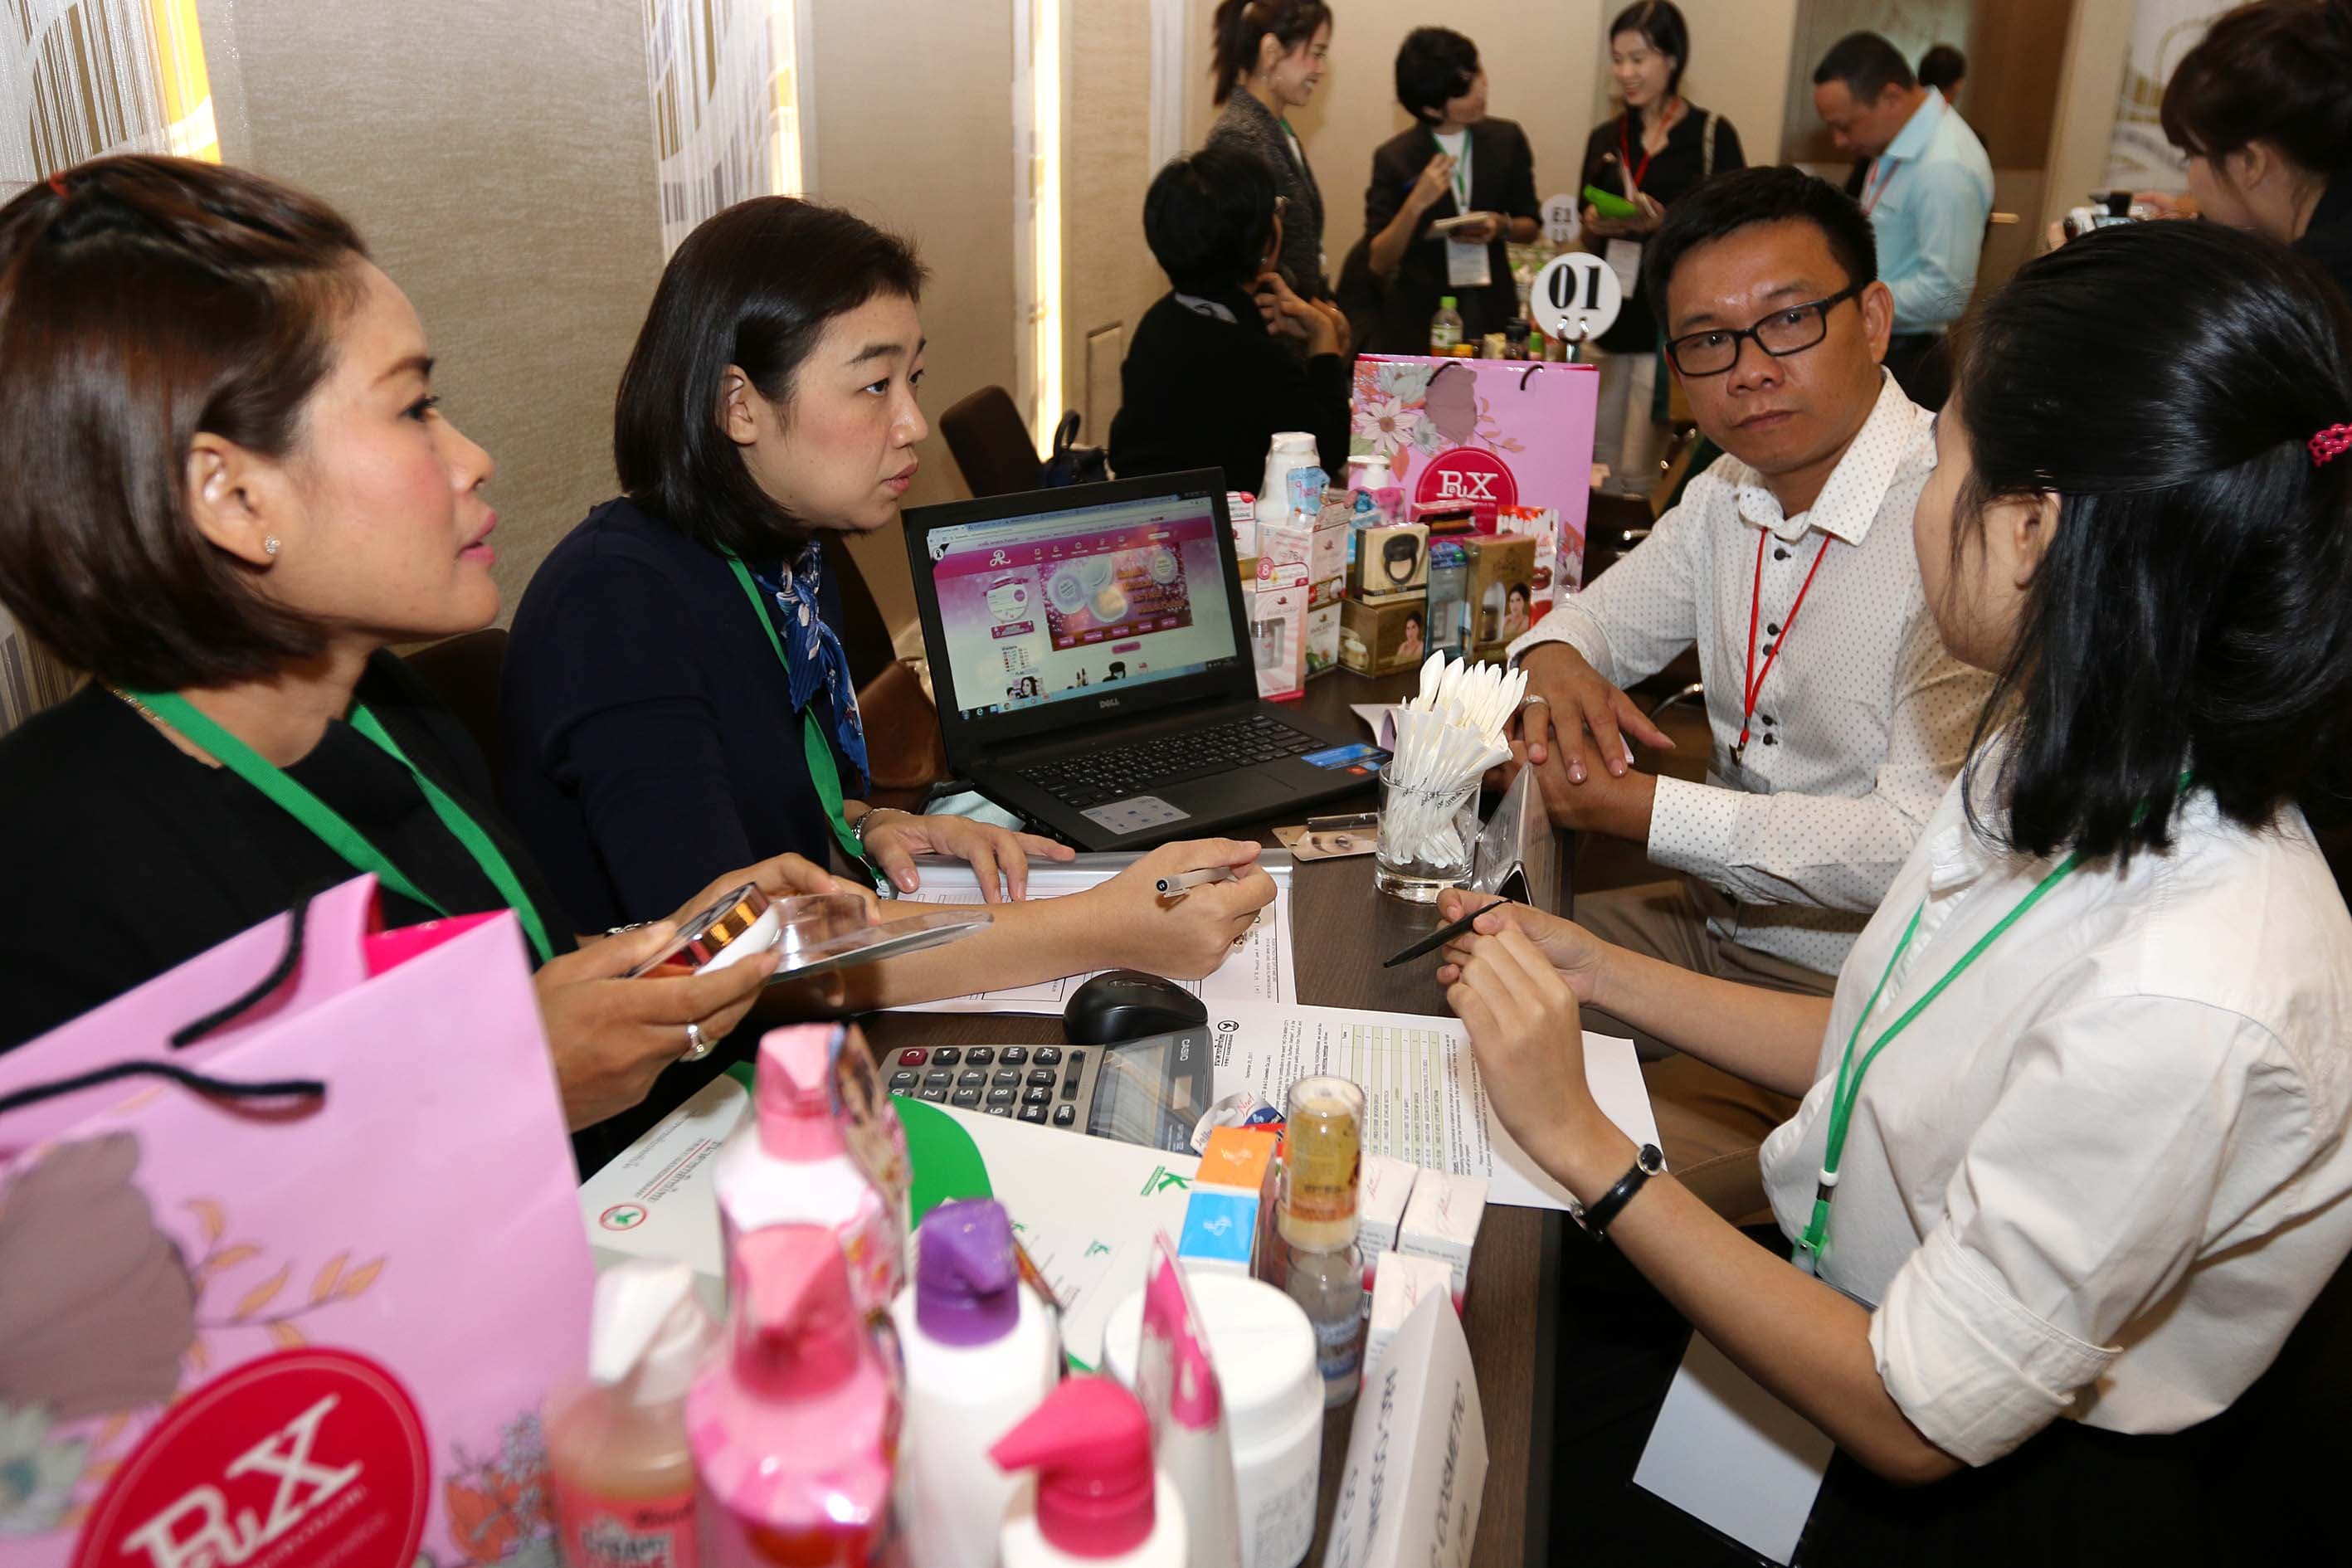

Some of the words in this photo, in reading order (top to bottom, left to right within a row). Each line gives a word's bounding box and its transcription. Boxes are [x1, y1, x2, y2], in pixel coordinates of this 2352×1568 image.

[1548, 263, 1601, 310] 01
[1098, 698, 1121, 709] DELL
[1042, 1048, 1054, 1058] AC
[1180, 1038, 1191, 1062] CASIO
[1030, 1087, 1044, 1098] MC
